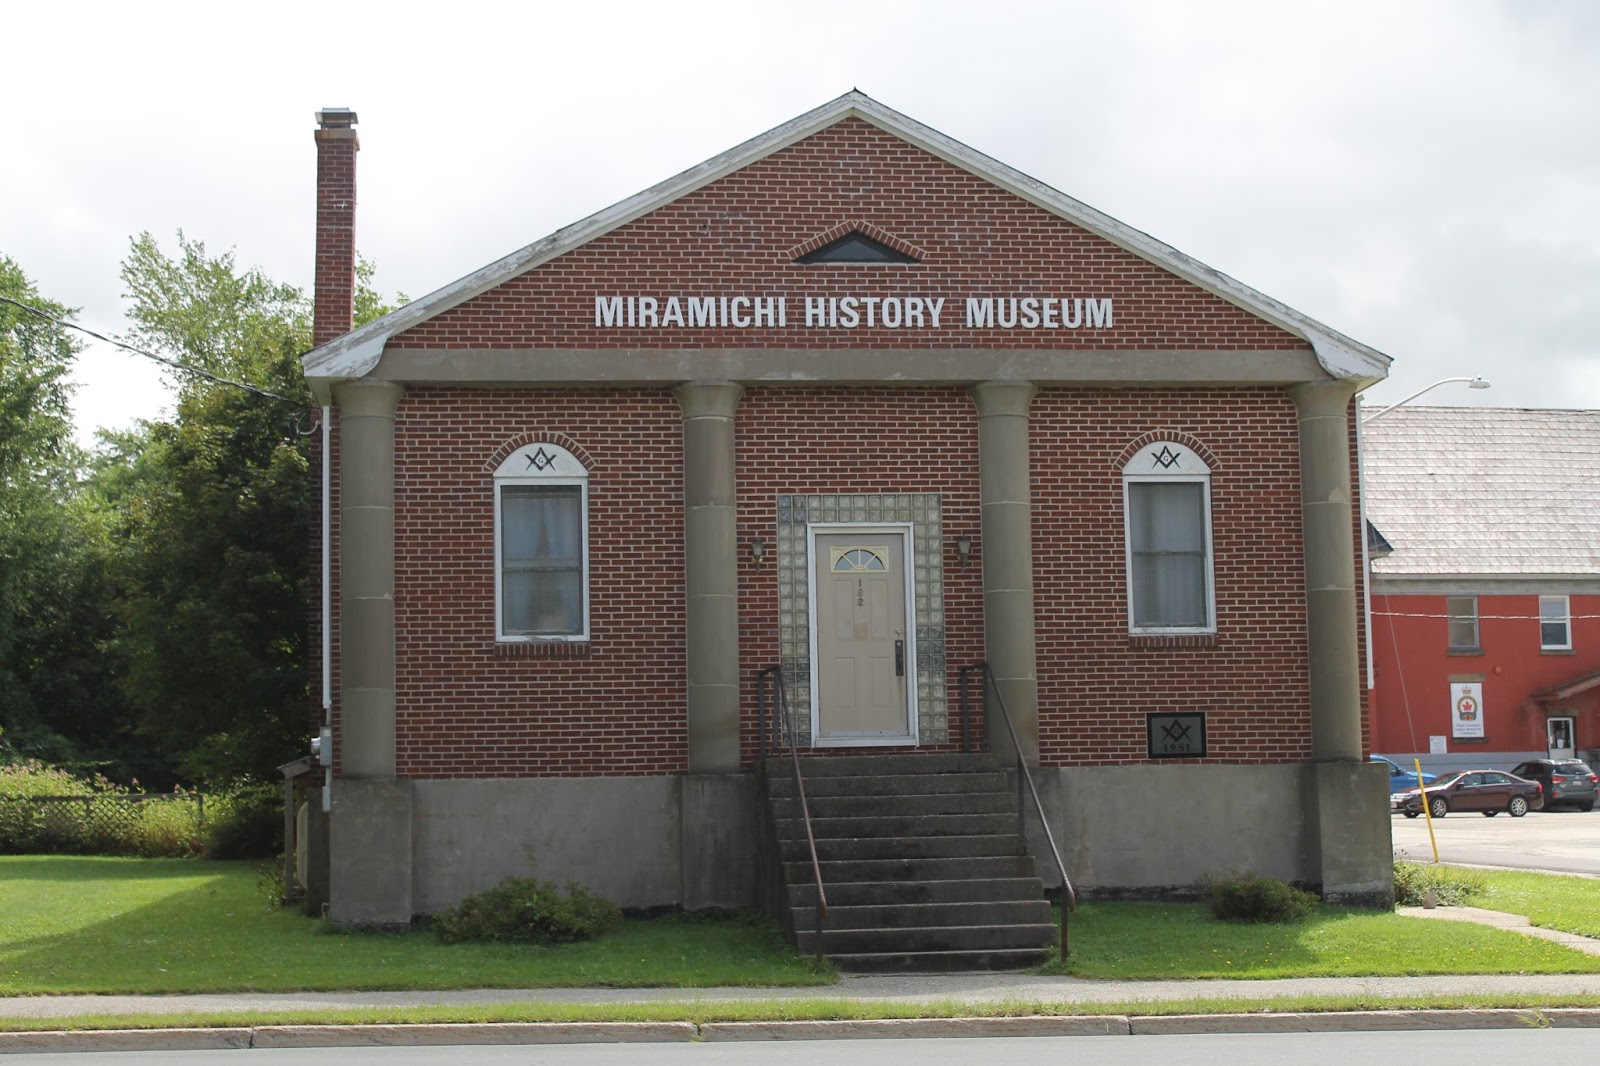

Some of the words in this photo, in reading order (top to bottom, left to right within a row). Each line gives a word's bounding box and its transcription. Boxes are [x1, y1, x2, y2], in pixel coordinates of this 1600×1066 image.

[594, 295, 787, 329] MIRAMICHI
[805, 296, 945, 329] HISTORY
[965, 297, 1113, 330] MUSEUM
[1164, 743, 1190, 752] 1951
